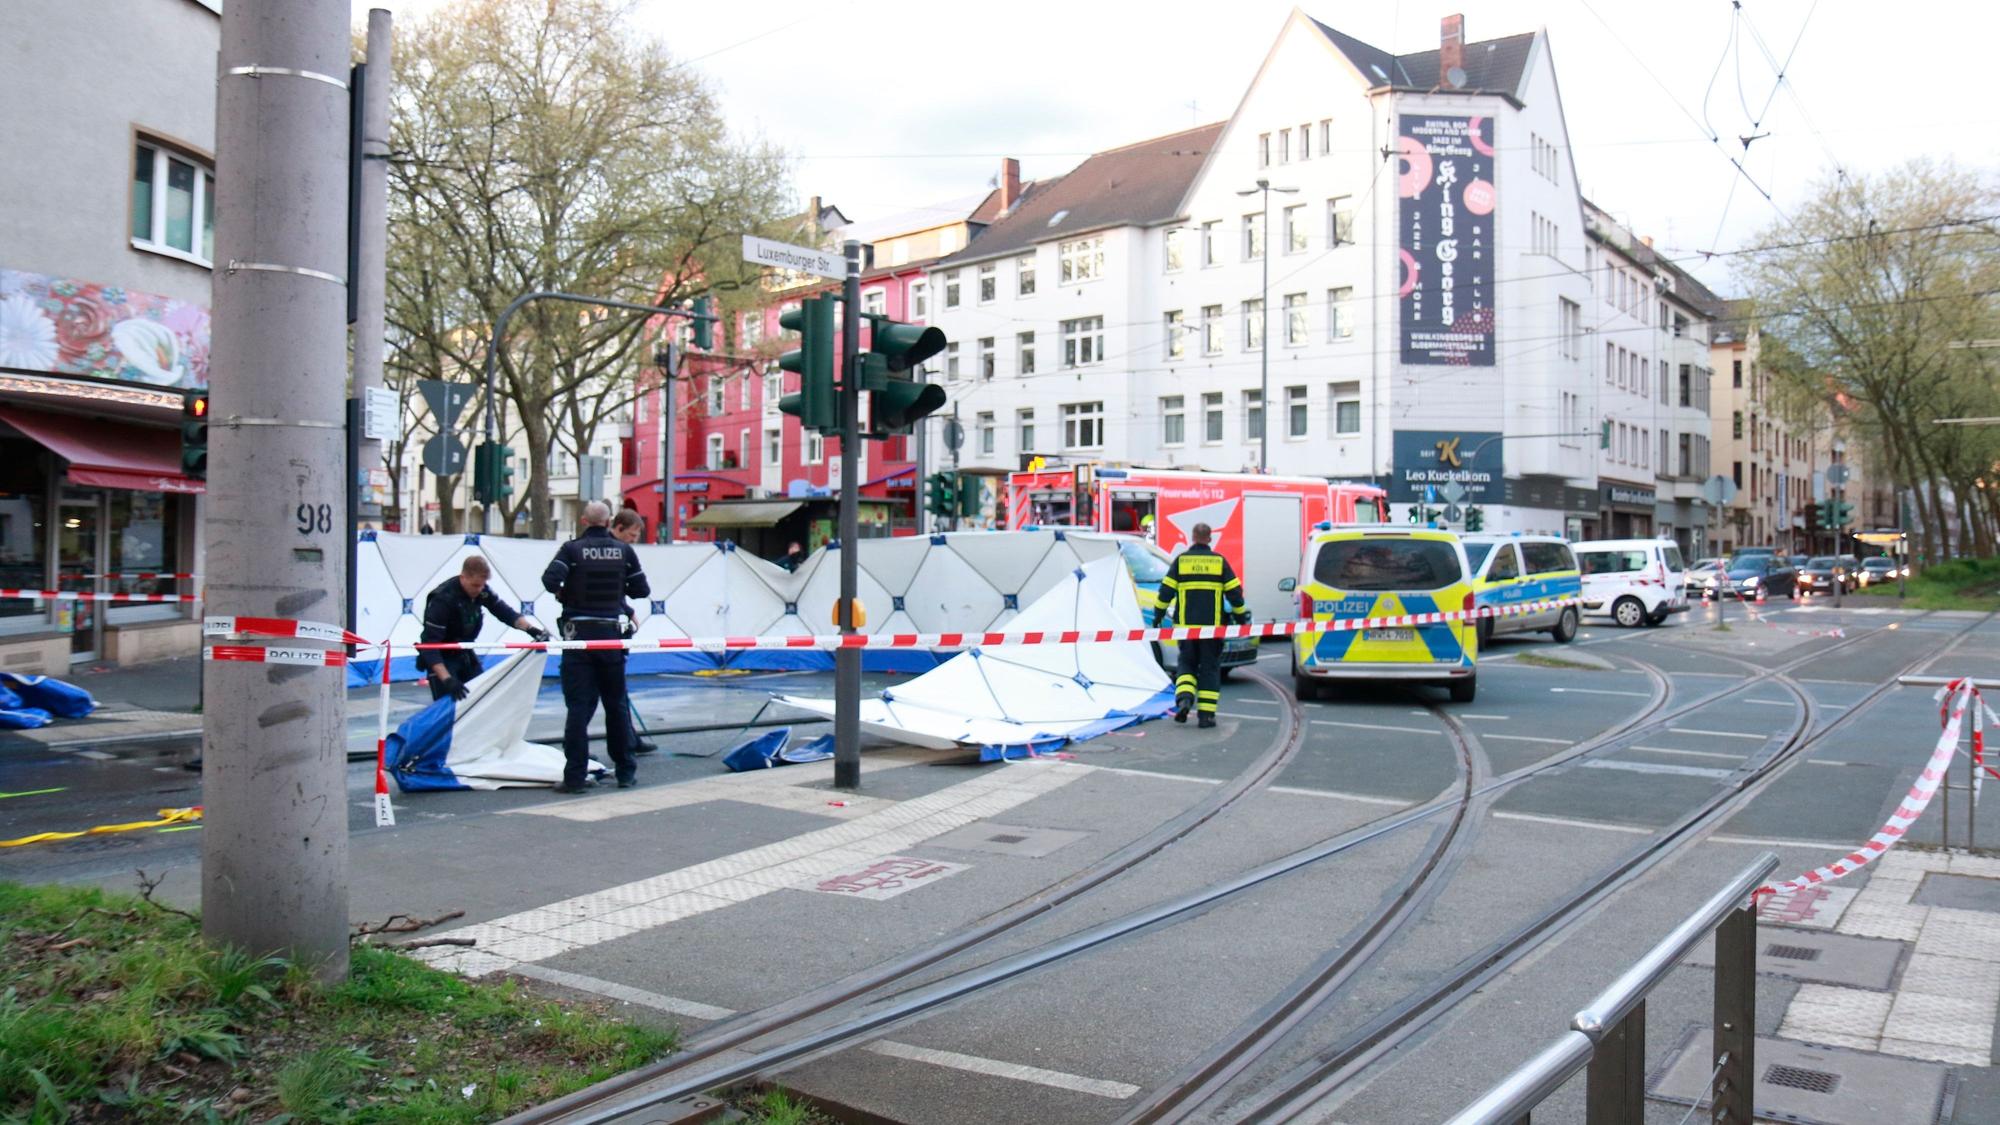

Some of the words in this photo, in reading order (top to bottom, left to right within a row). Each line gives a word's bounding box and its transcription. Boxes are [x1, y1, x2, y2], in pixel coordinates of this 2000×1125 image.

[1412, 127, 1443, 135] MODERN
[1432, 136, 1450, 144] JAZZ
[757, 243, 815, 270] Luxemburger
[817, 256, 832, 272] Str.
[1405, 470, 1426, 480] Leo
[1428, 470, 1491, 482] Kuckelkorn
[297, 503, 331, 534] 98
[582, 547, 622, 560] POLIZEI
[1314, 601, 1369, 612] POLIZEI
